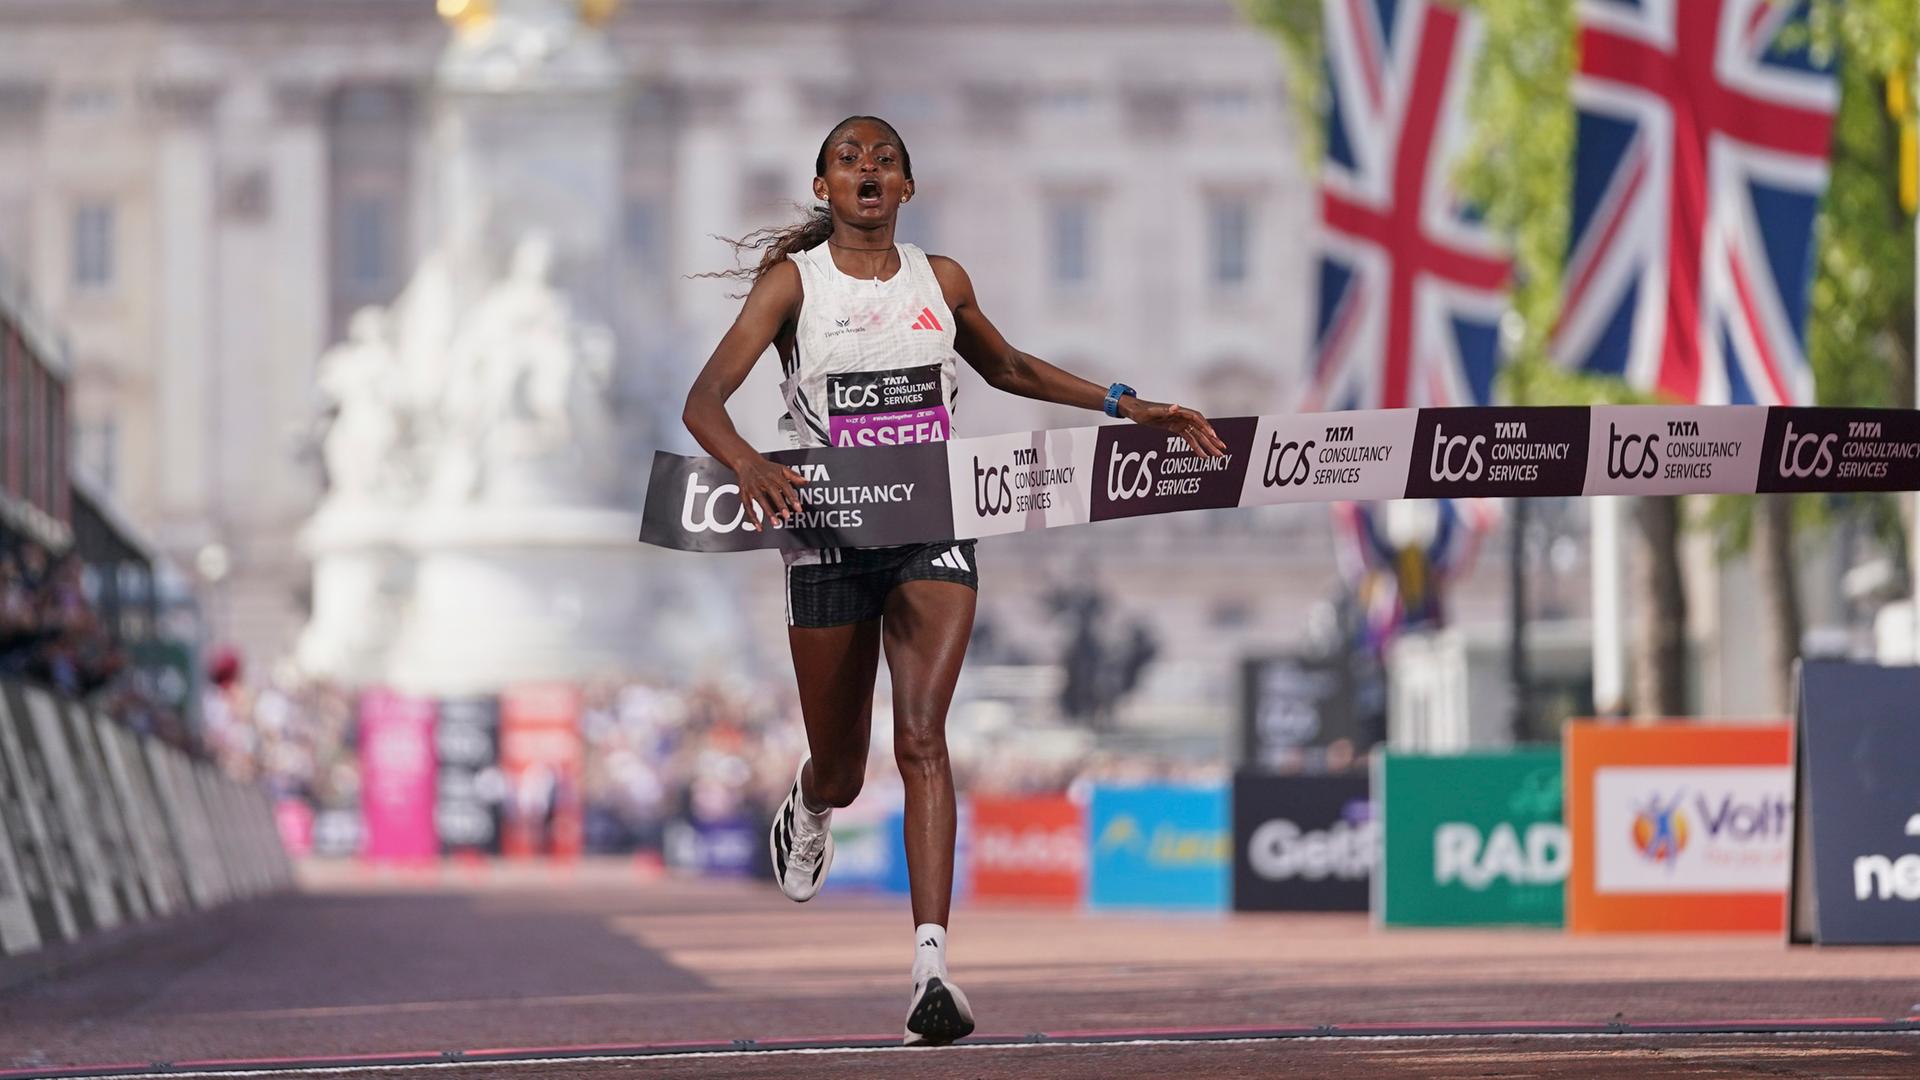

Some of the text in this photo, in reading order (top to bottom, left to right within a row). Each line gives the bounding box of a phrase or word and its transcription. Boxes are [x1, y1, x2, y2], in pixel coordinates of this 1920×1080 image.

[883, 375, 909, 386] TATA
[883, 381, 936, 396] CONSULTANCY
[834, 381, 880, 408] tcs
[884, 393, 923, 406] SERVICES
[1325, 426, 1354, 442] TATA
[1494, 422, 1527, 439] TATA
[1667, 421, 1700, 436] TATA
[1848, 421, 1881, 438] TATA
[1013, 448, 1038, 466] TATA
[1318, 445, 1392, 464] CONSULTANCY
[1430, 423, 1486, 482] tcs
[1491, 443, 1570, 460] CONSULTANCY
[1607, 422, 1660, 479] tcs
[1666, 441, 1742, 458] CONSULTANCY
[1779, 421, 1838, 478] tcs
[1160, 454, 1232, 475] CONSULTANCY
[1263, 430, 1316, 488] tcs
[787, 464, 831, 482] ATA
[1015, 467, 1075, 489] CONSULTANCY
[1107, 440, 1158, 501] tcs
[1313, 467, 1361, 485] SERVICES
[1488, 464, 1539, 481] SERVICES
[1664, 463, 1712, 479] SERVICES
[1836, 462, 1889, 478] SERVICES
[785, 483, 915, 505] ONSULTANCY
[973, 455, 1012, 517] tcs
[1155, 477, 1201, 497] SERVICES
[1016, 492, 1051, 512] SERVICES
[773, 509, 863, 529] SERVICES
[1433, 821, 1572, 891] RAD
